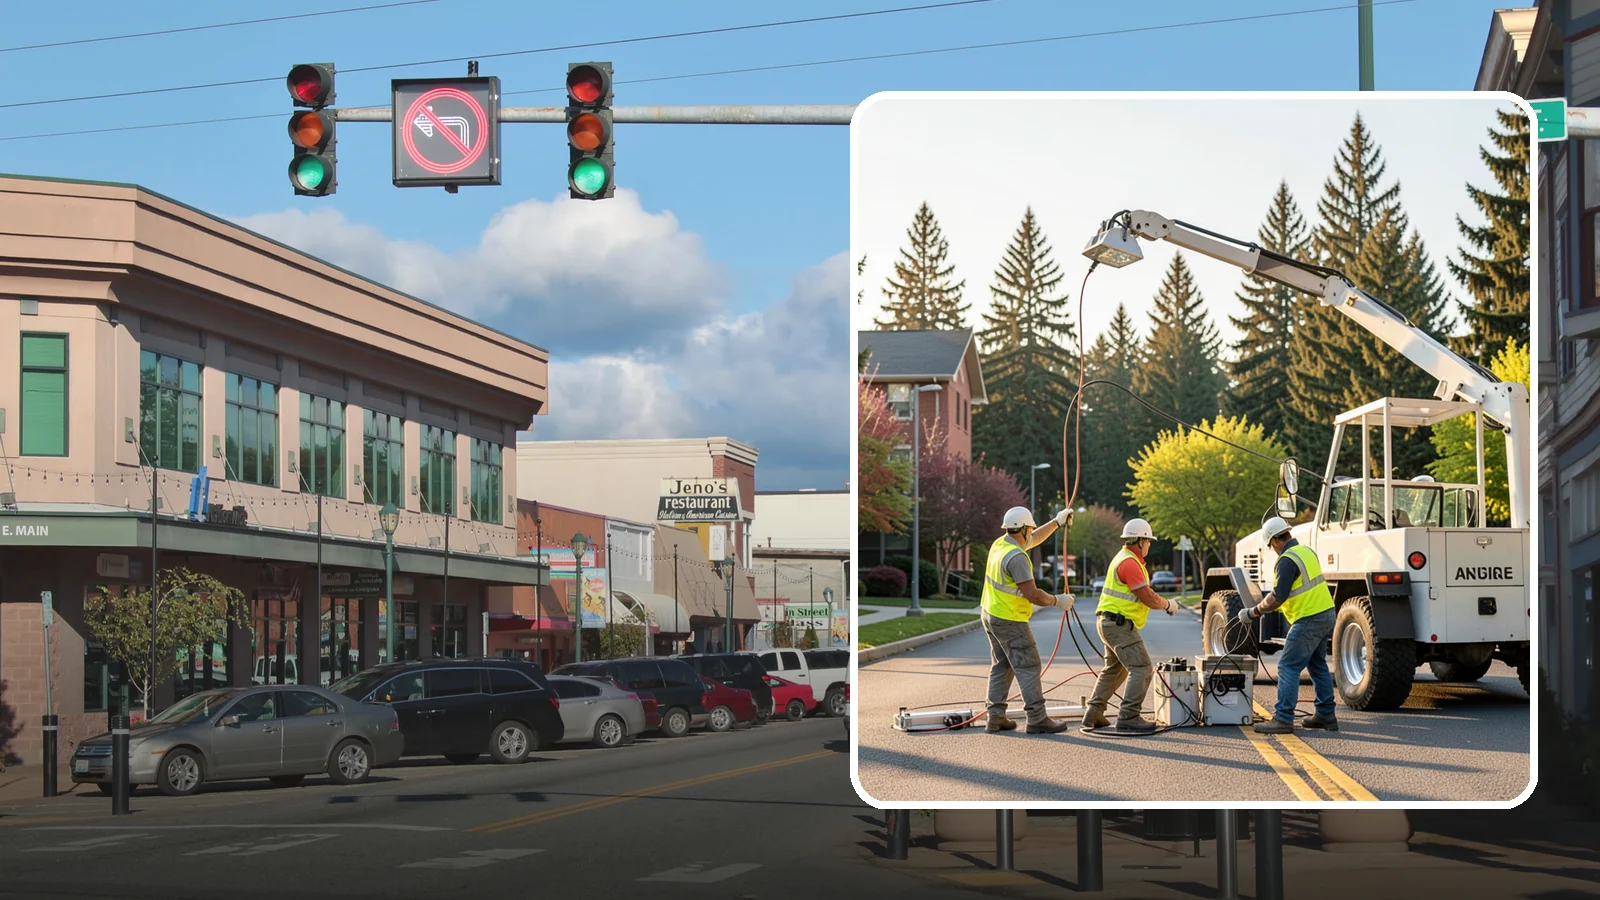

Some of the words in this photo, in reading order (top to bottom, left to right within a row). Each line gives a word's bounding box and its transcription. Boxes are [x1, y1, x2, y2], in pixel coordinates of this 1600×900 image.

[669, 480, 728, 495] Jeno's
[665, 496, 731, 509] restaurant
[686, 510, 715, 519] American
[715, 509, 738, 519] Cuisine
[2, 525, 13, 536] E.
[15, 525, 49, 536] MAIN
[797, 607, 829, 617] Street
